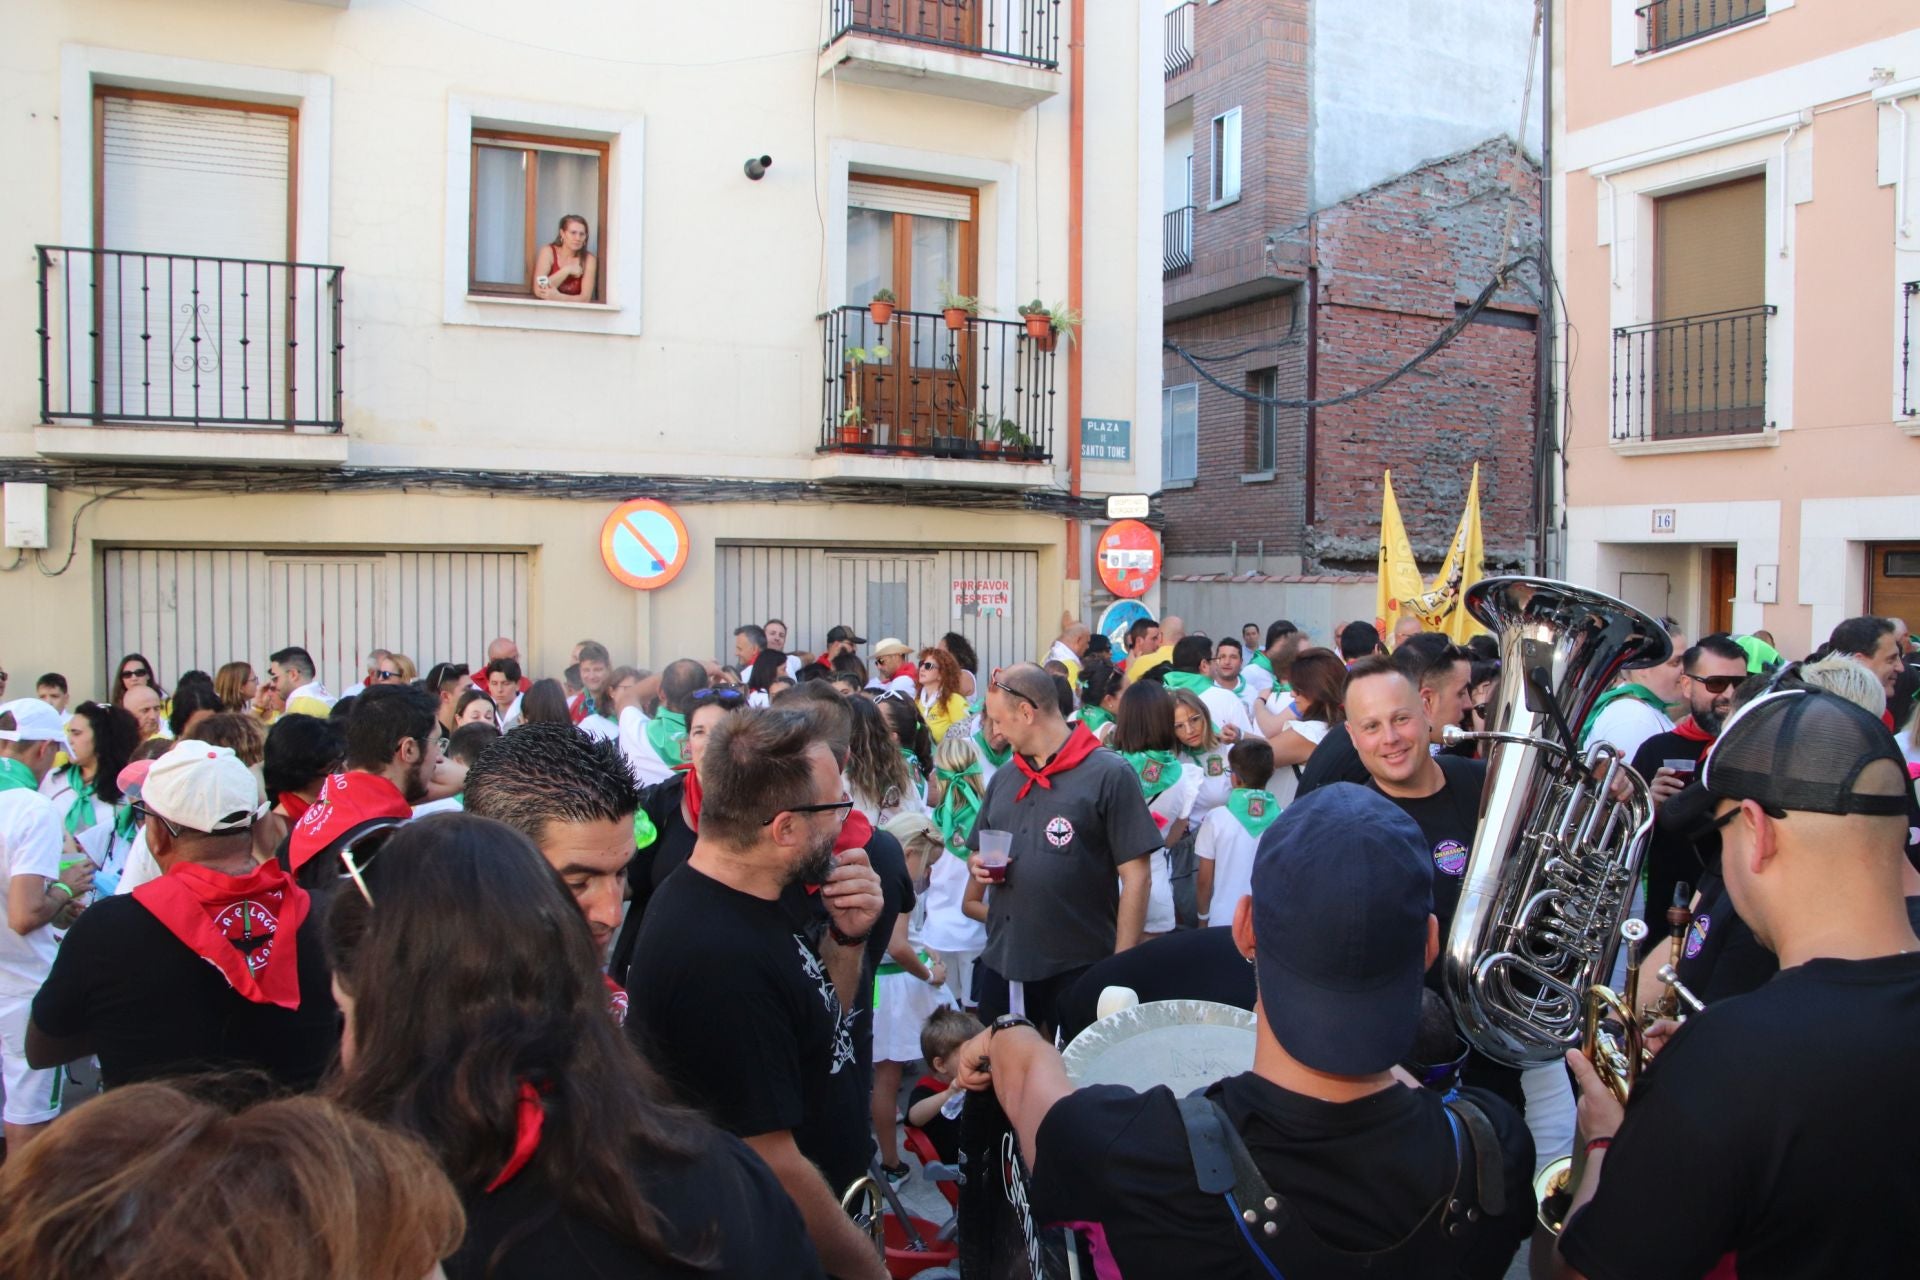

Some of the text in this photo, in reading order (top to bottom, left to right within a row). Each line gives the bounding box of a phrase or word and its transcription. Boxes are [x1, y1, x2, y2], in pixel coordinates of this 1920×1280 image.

[1087, 421, 1120, 433] PLAZA
[1081, 444, 1126, 458] SANTO TOME
[1656, 514, 1671, 528] 16
[953, 580, 1009, 590] POR FAVOR
[955, 594, 1008, 604] RESPETEN
